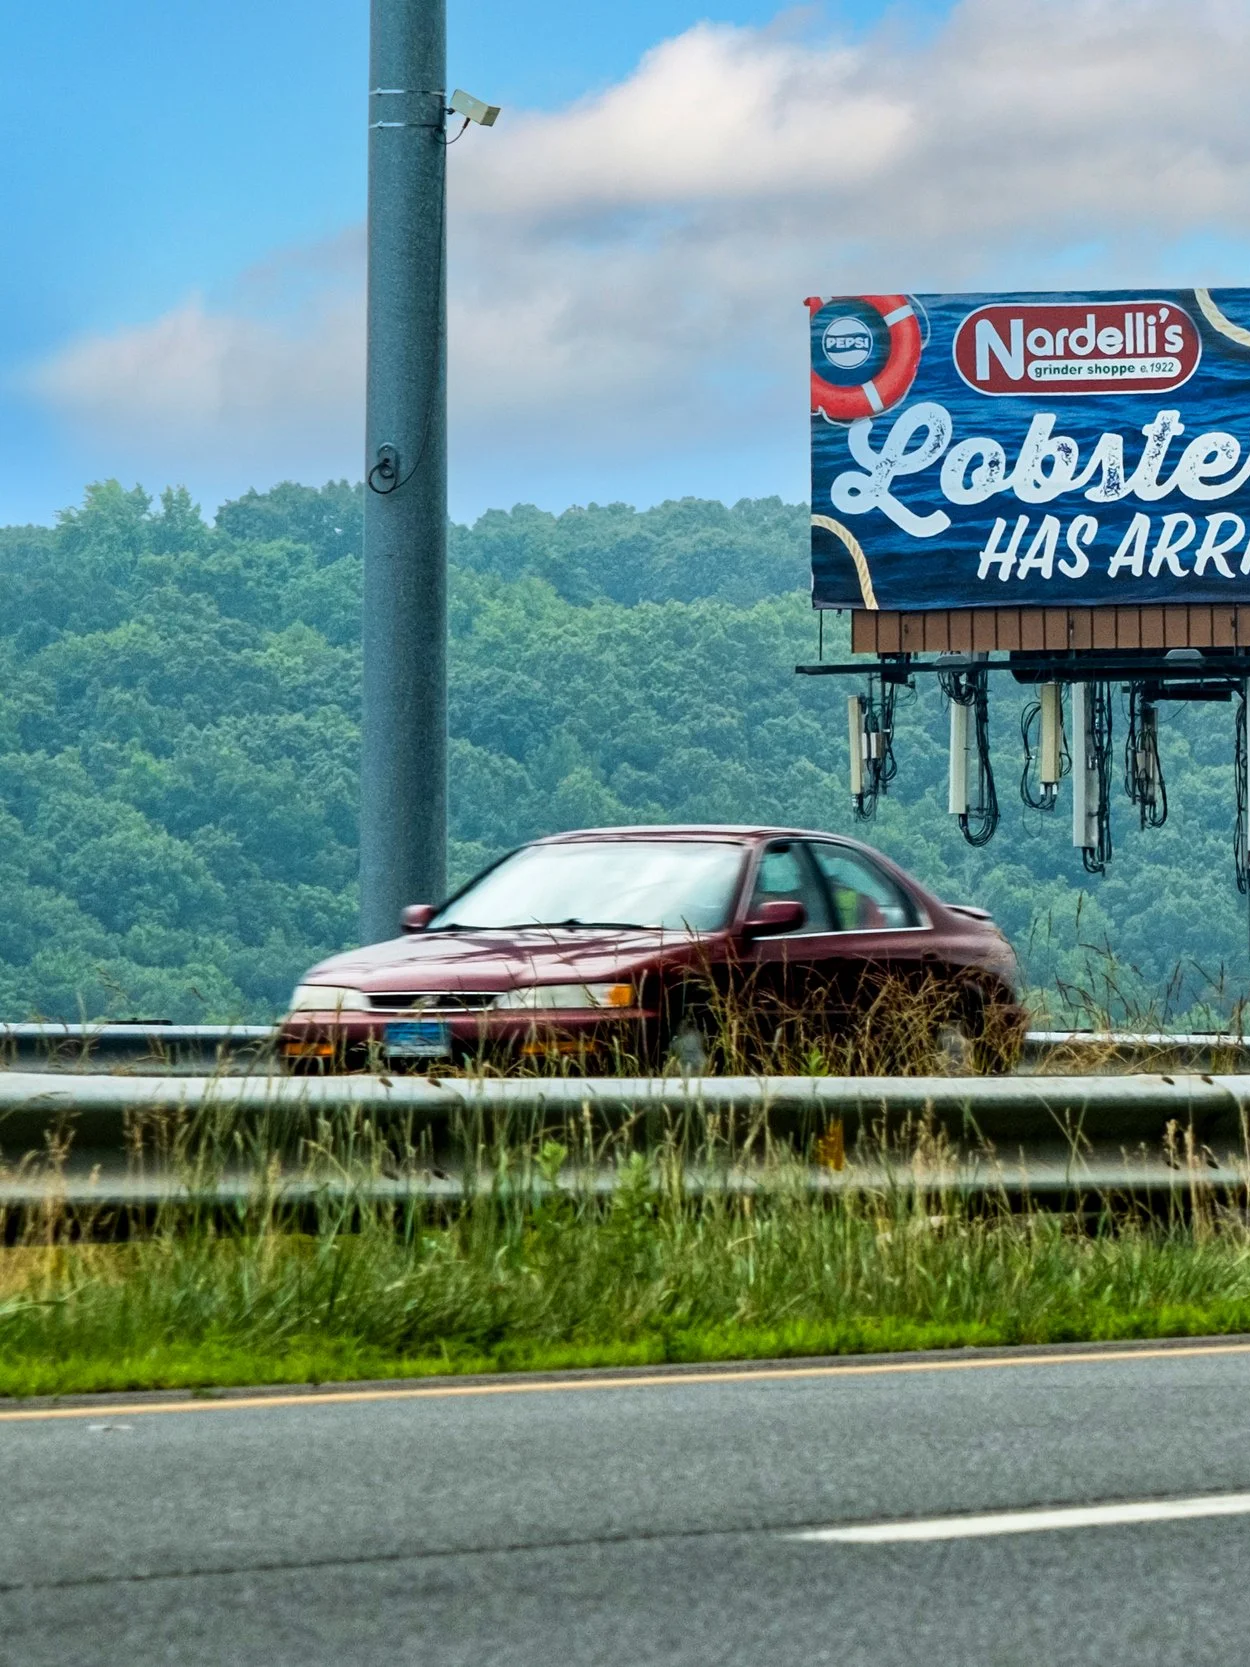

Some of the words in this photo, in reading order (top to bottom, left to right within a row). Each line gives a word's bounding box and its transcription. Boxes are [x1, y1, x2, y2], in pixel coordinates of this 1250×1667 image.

[826, 337, 869, 349] PEPSI
[975, 307, 1184, 381] Nardelli's
[1034, 364, 1082, 377] grinder
[1087, 363, 1135, 376] shoppe
[977, 512, 1100, 581] HAS
